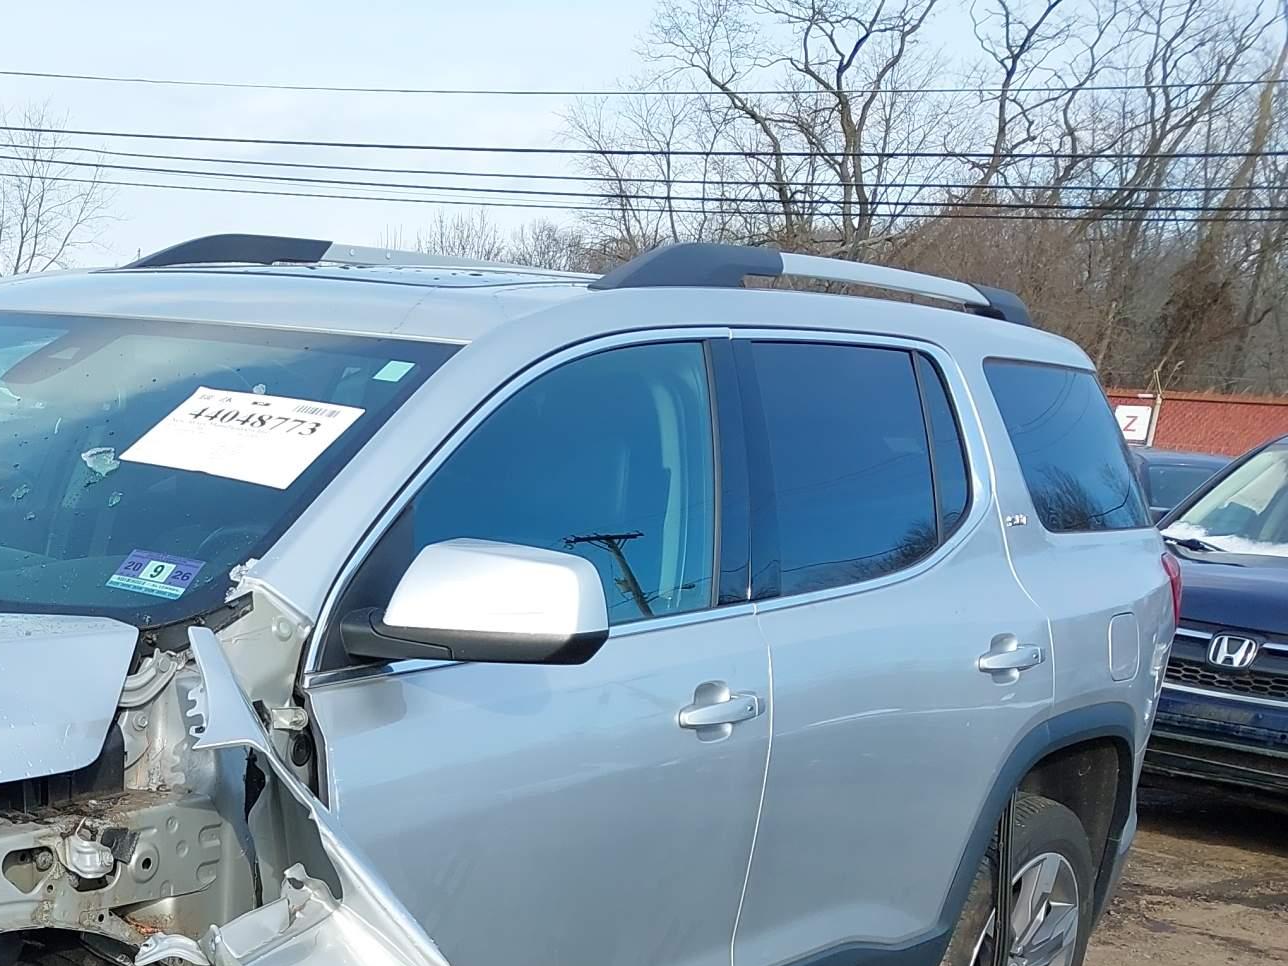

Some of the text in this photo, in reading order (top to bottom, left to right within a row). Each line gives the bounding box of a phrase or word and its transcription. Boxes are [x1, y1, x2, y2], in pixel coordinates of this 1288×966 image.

[189, 406, 322, 436] 44048773
[1122, 415, 1139, 432] Z
[124, 561, 192, 581] 20 9 26
